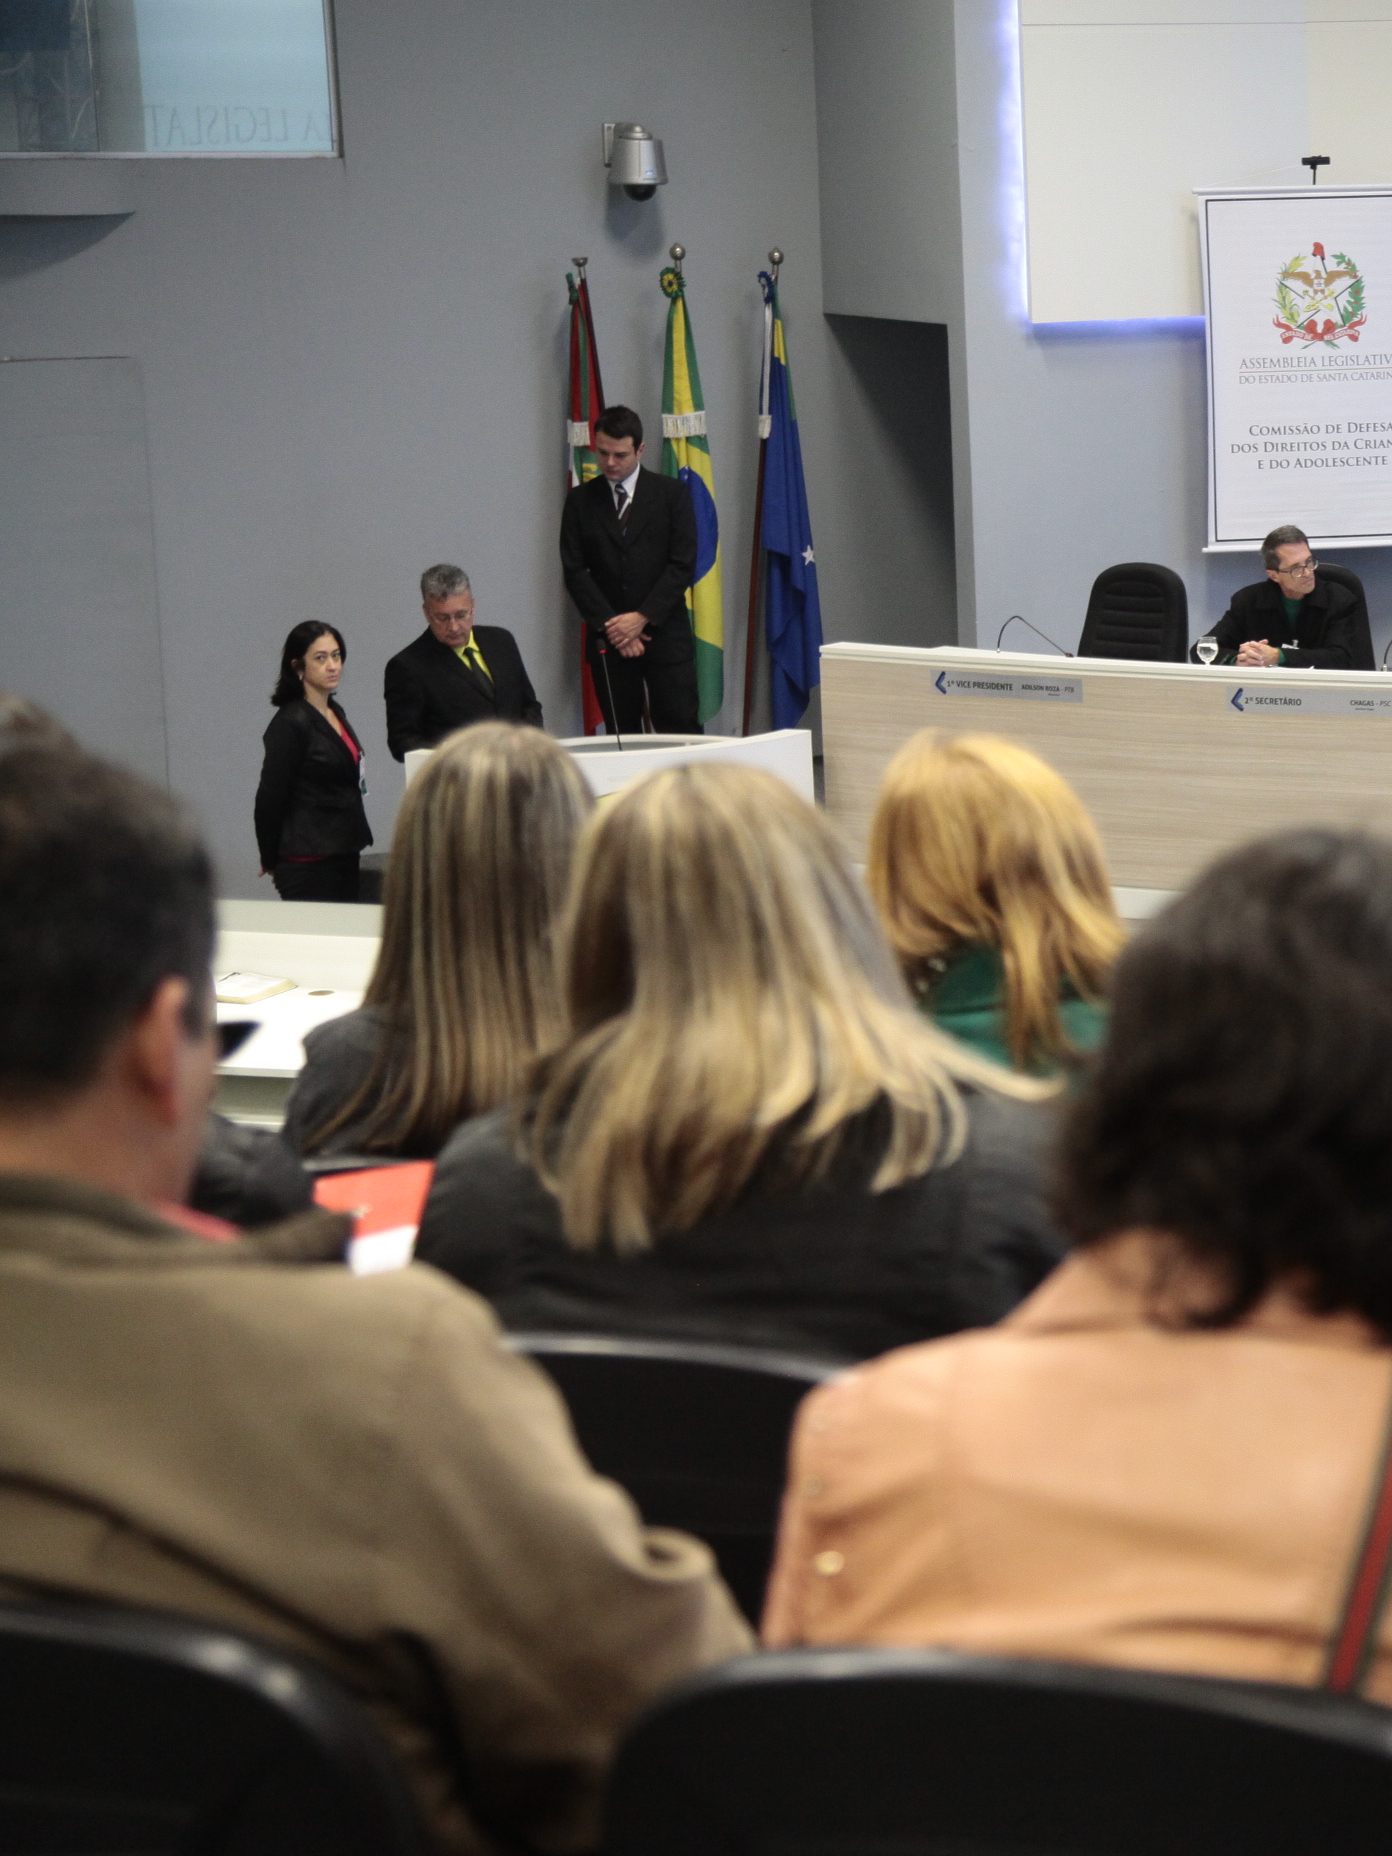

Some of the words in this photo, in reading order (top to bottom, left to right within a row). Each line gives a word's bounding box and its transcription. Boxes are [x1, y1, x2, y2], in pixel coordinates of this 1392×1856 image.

[1239, 356, 1317, 370] ASSEMBLEIA
[1239, 376, 1256, 384] DO
[1258, 374, 1298, 384] ESTADO
[1300, 374, 1314, 382] DE
[1317, 372, 1348, 382] SANTA
[1249, 423, 1320, 436] COMISSÃO
[1325, 424, 1343, 434] DE
[1230, 443, 1258, 454] DOS
[1263, 441, 1327, 453] DIREITOS
[1332, 440, 1350, 451] DA
[1257, 460, 1265, 470] E
[1269, 459, 1290, 469] DO
[1293, 456, 1388, 469] ADOLESCENTE
[956, 681, 971, 689] VICE
[972, 682, 1013, 691] PRESIDENTE
[1244, 696, 1254, 704] 2º
[1255, 696, 1302, 706] SECRETÁRIO
